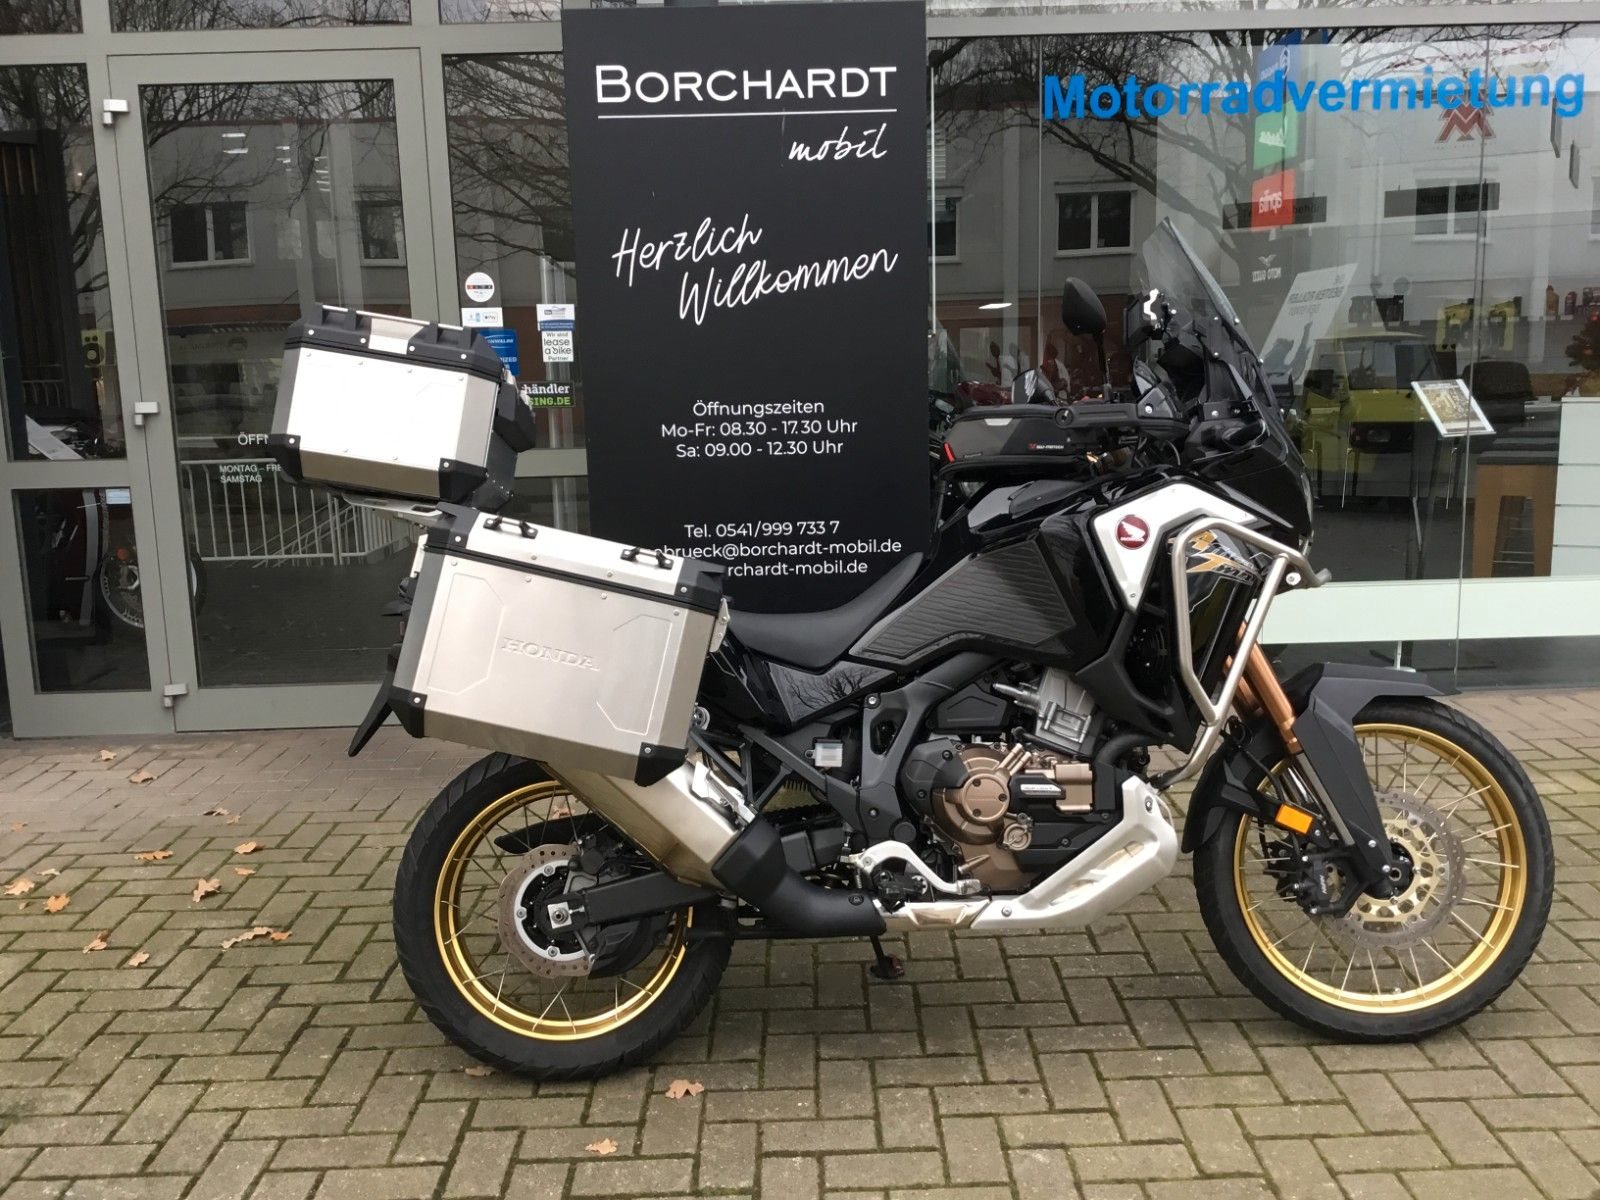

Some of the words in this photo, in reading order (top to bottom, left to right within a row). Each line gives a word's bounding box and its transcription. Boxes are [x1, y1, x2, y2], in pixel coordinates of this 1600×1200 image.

[595, 64, 898, 104] BORCHARDT
[1043, 67, 1585, 120] Motorradvermietung
[787, 122, 888, 162] mobil
[611, 213, 763, 287] Herzlich
[678, 248, 899, 326] Willkommen
[543, 338, 570, 346] lease
[692, 399, 825, 418] Öffnungszeiten
[661, 422, 716, 438] Mo-Fr:
[719, 421, 767, 437] 08.30
[781, 419, 822, 435] 17.30
[826, 418, 858, 434] Uhr
[676, 443, 701, 458] Sa:
[704, 441, 752, 457] 09.00
[766, 440, 808, 456] 12.30
[812, 439, 844, 455] Uhr
[219, 464, 258, 473] MONTAG
[220, 475, 262, 483] SAMSTAG
[683, 523, 712, 538] Tel.
[715, 521, 793, 538] 0541/999
[796, 520, 826, 535] 733
[829, 520, 840, 534] 7
[727, 559, 868, 578] rchardt-mobil.de
[501, 636, 600, 672] HONDA
